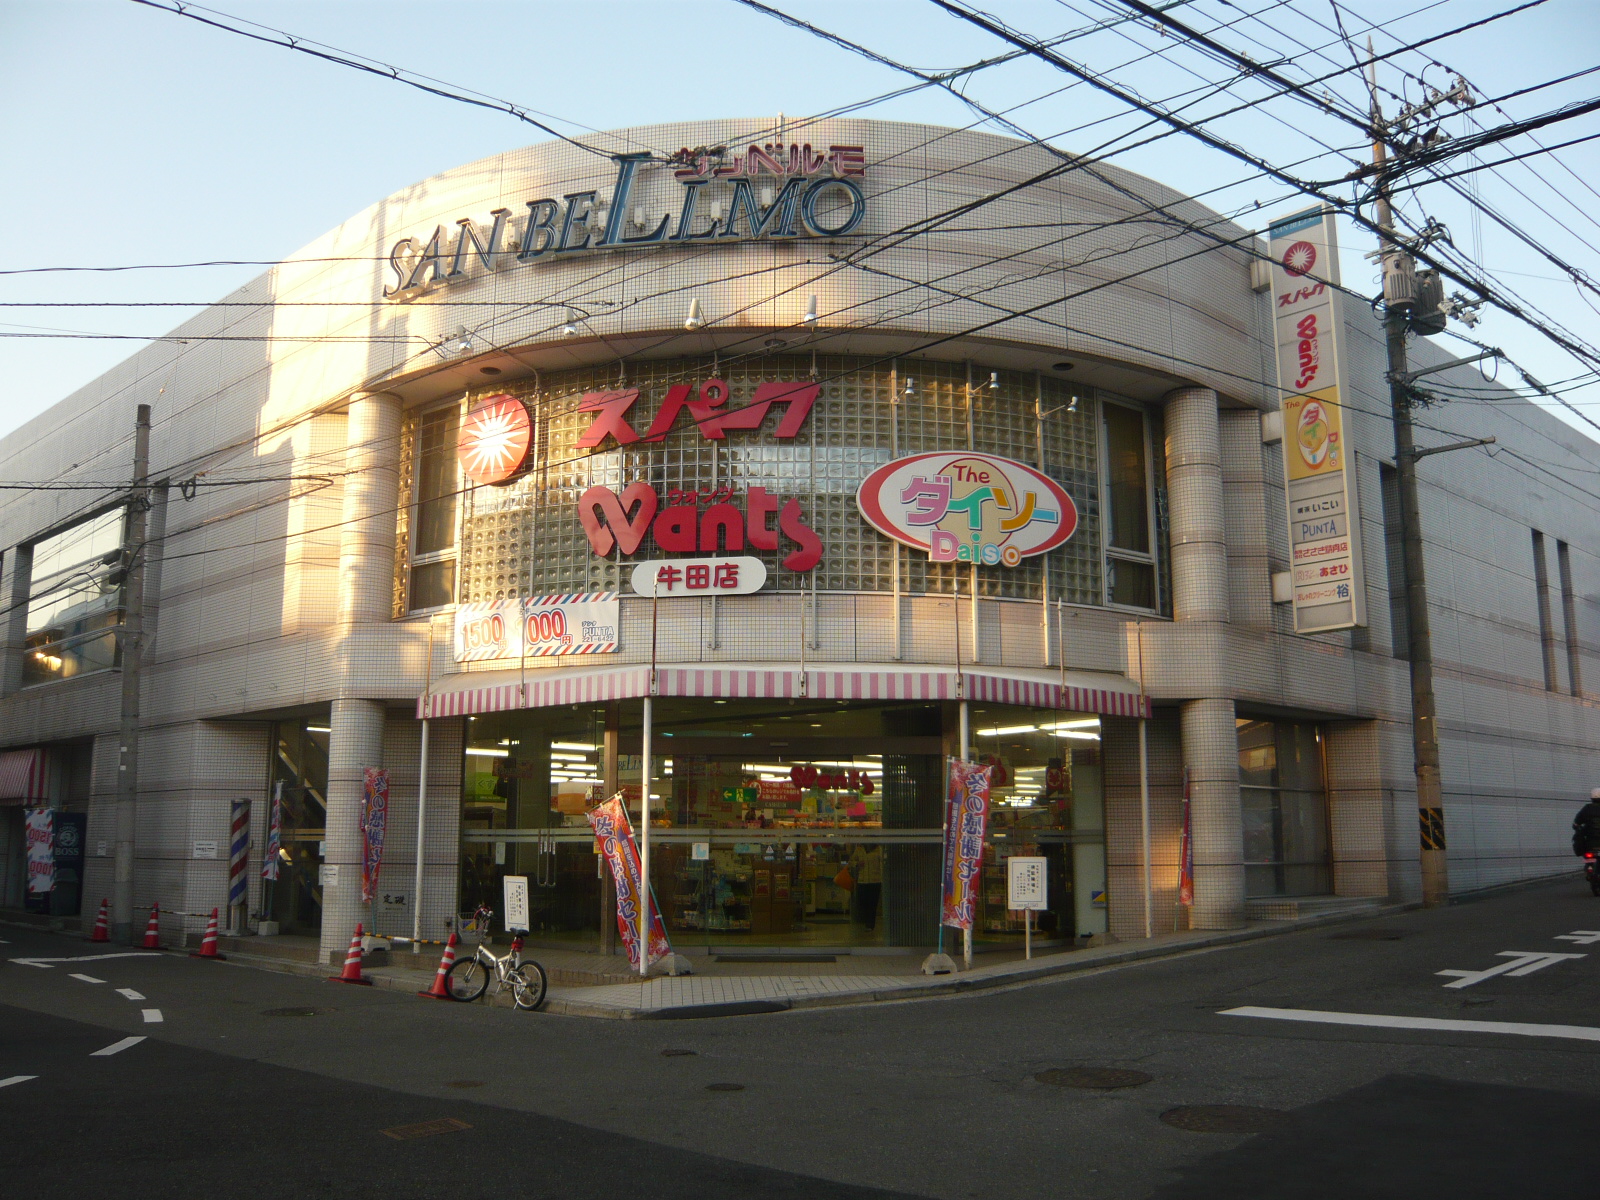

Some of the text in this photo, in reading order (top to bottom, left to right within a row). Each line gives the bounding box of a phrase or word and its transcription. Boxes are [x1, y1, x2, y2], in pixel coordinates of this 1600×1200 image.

[383, 150, 866, 301] SAN BELLMO
[1295, 313, 1319, 389] Wants
[1285, 401, 1300, 410] The
[1303, 405, 1321, 465] ダイソー
[952, 463, 991, 485] The
[667, 486, 735, 505] ウォンツ
[899, 475, 1059, 534] ダイソー
[1312, 500, 1339, 513] いこい
[577, 481, 824, 572] Wants
[1302, 519, 1337, 541] PUNTA
[931, 528, 1022, 567] Daiso
[656, 562, 739, 591] 牛田店
[1320, 564, 1348, 578] あさひ
[1337, 583, 1349, 599] 裕
[582, 625, 615, 637] PUNTA
[790, 766, 875, 796] Wants
[54, 847, 79, 856] BOSS
